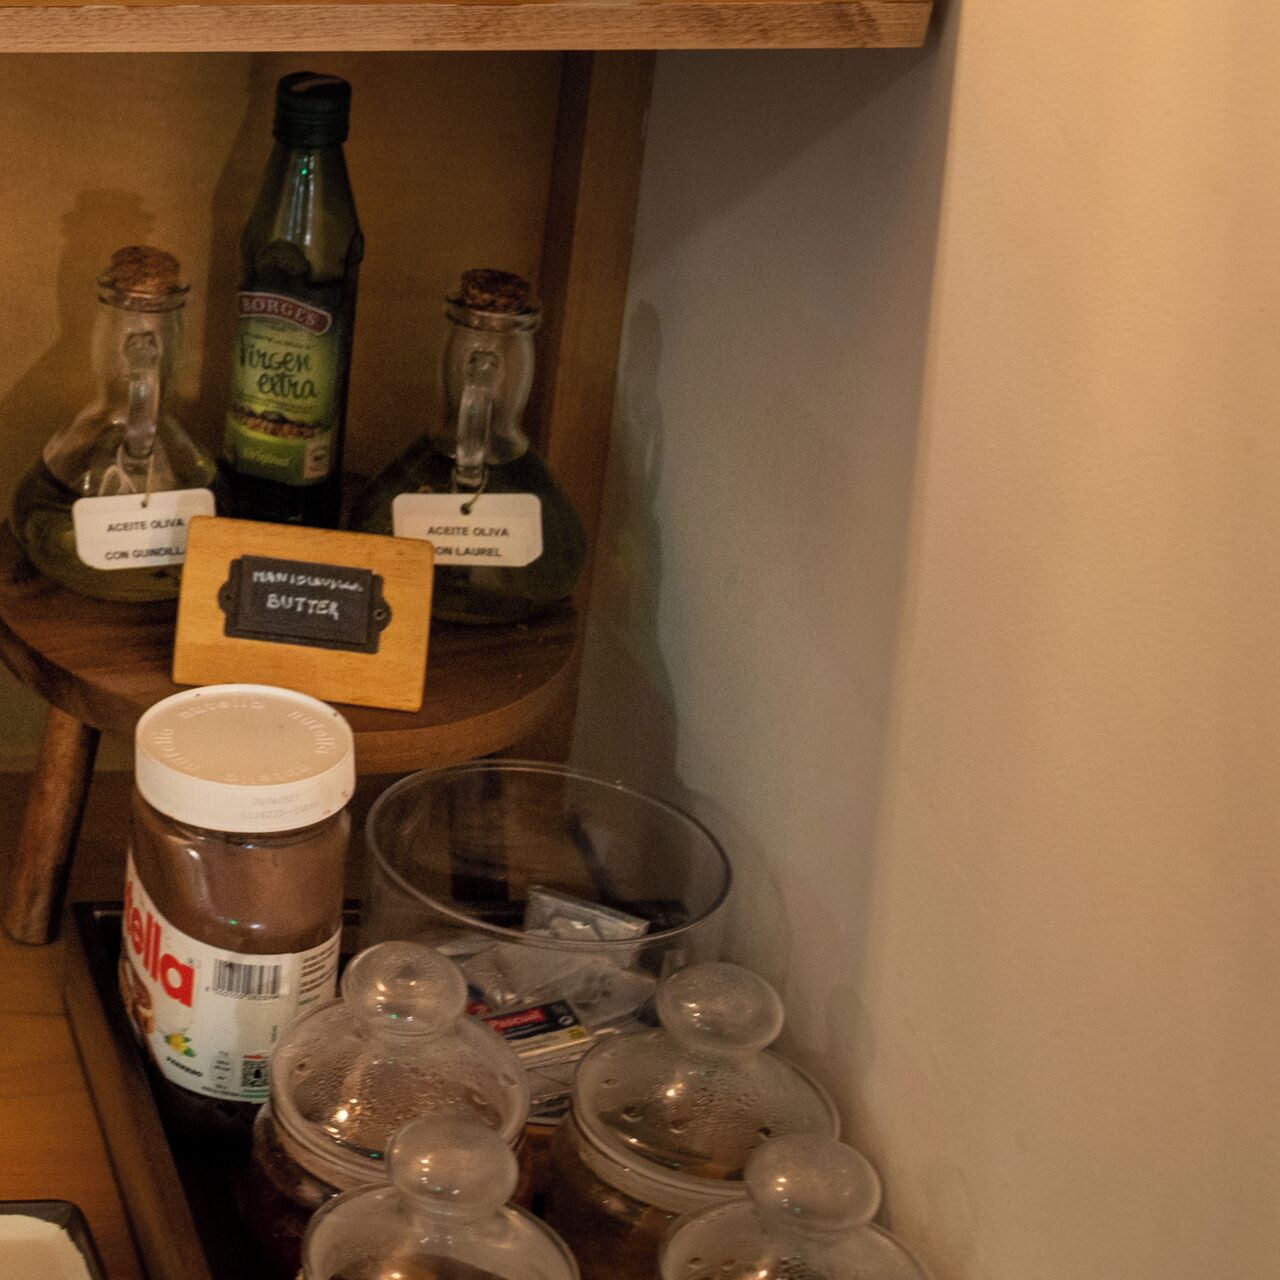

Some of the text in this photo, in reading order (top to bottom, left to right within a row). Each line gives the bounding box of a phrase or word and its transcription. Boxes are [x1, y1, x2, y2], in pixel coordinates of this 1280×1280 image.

[241, 297, 319, 326] BORGES
[257, 372, 319, 399] extra
[107, 518, 185, 532] ACEITE OLIVA
[427, 526, 510, 538] ACEITE OLIVA
[104, 549, 130, 561] CON
[435, 546, 503, 558] ON LAUREL
[266, 593, 340, 620] BUTTER
[124, 880, 195, 1008] tella
